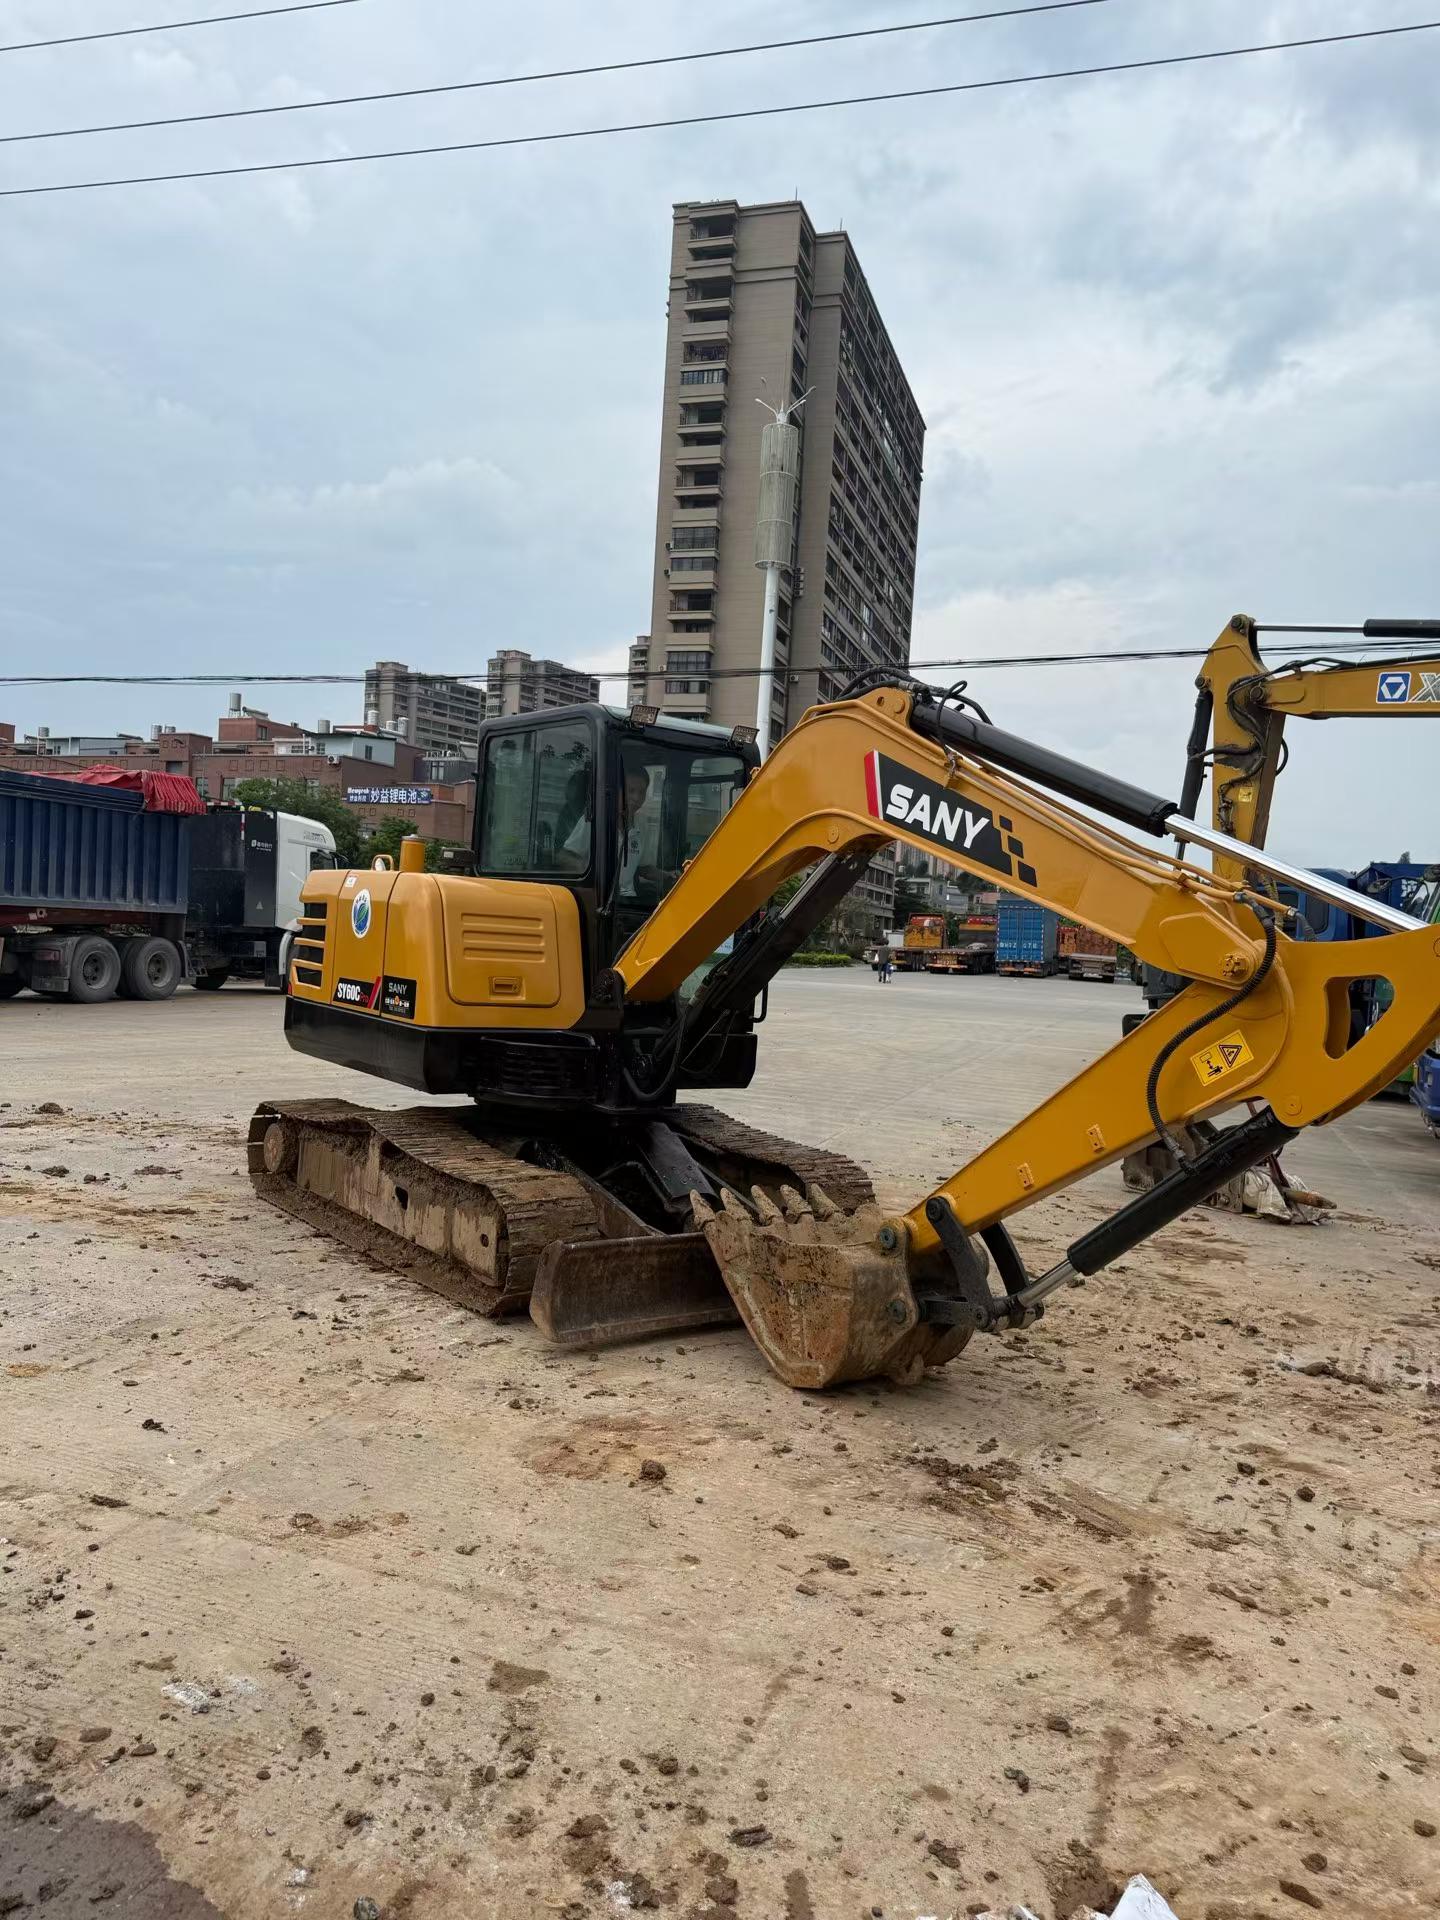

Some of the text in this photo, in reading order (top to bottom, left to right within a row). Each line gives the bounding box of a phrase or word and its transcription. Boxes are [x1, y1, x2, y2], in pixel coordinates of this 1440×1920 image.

[370, 788, 417, 804] 妙益锂电池
[886, 784, 990, 849] SANY
[388, 983, 407, 995] SANY
